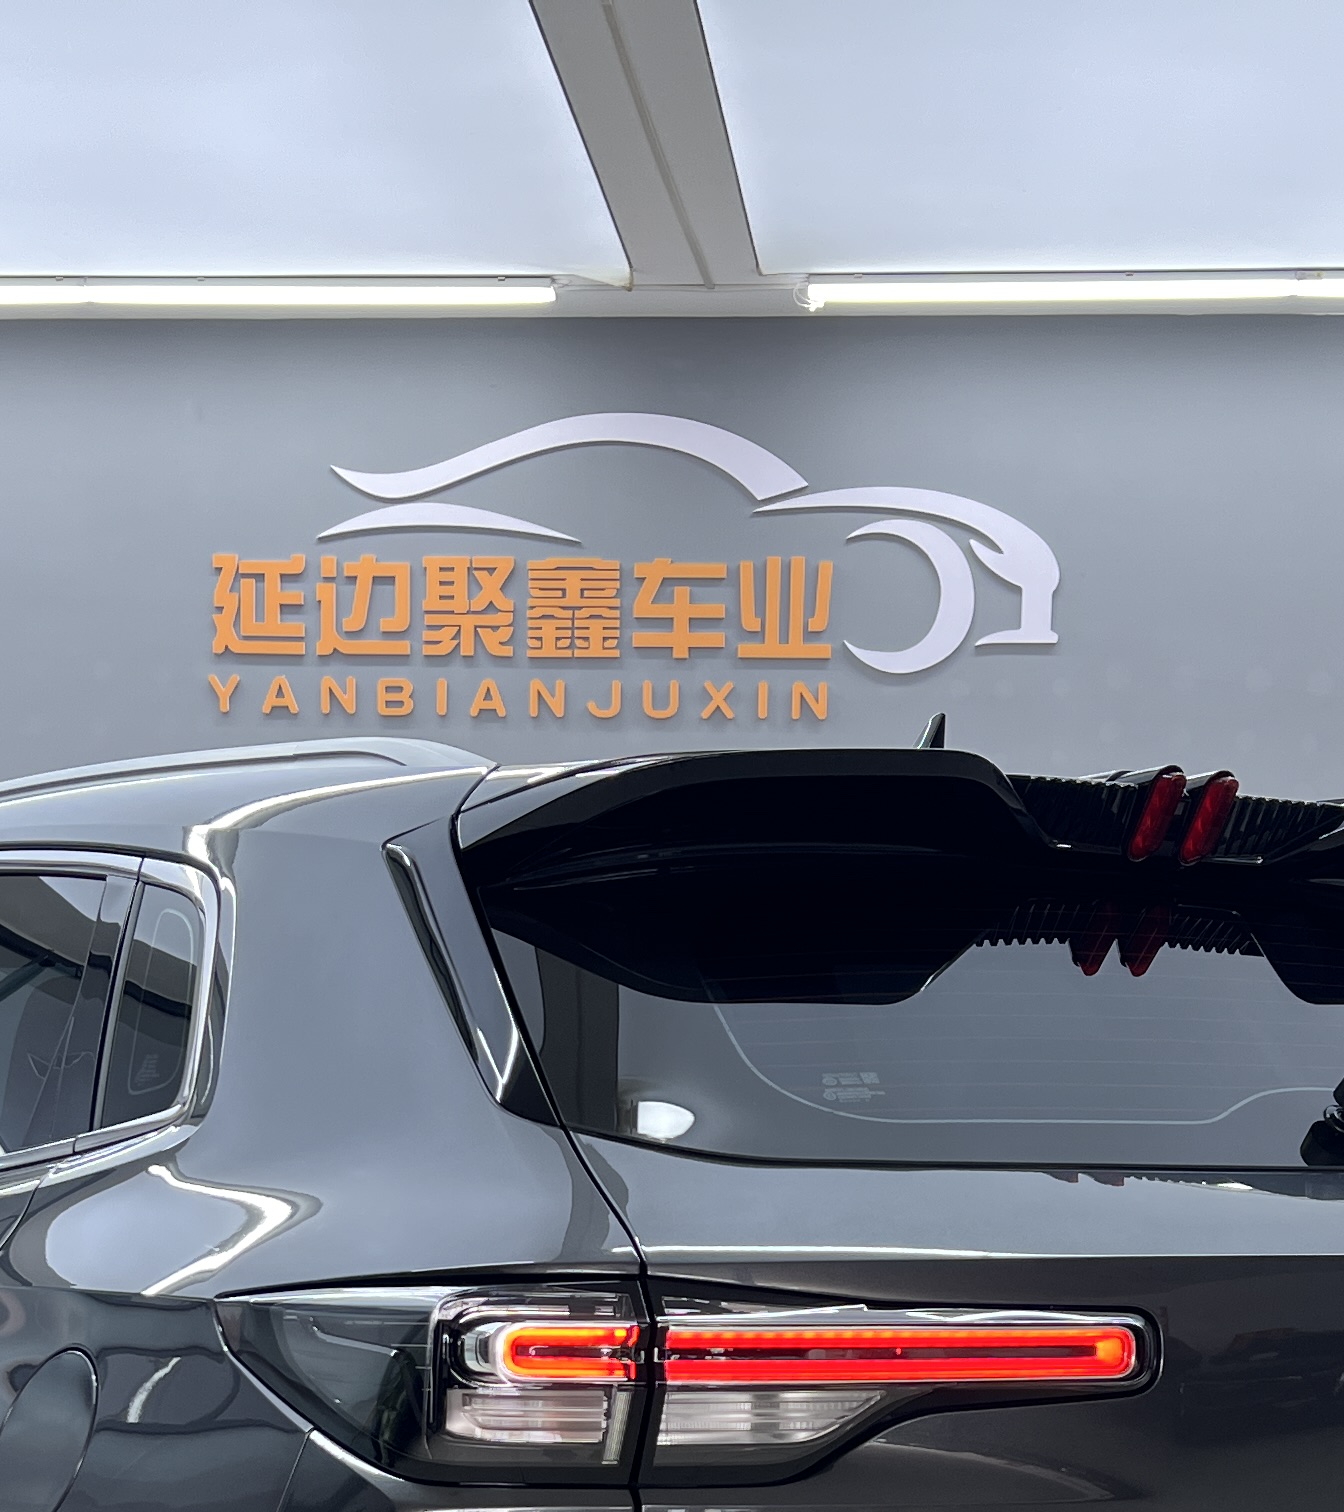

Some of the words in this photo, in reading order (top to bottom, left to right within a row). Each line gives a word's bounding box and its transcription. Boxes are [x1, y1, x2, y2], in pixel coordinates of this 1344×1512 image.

[212, 554, 833, 659] 延边聚鑫车业
[208, 674, 828, 720] YANBIANJUXIN
